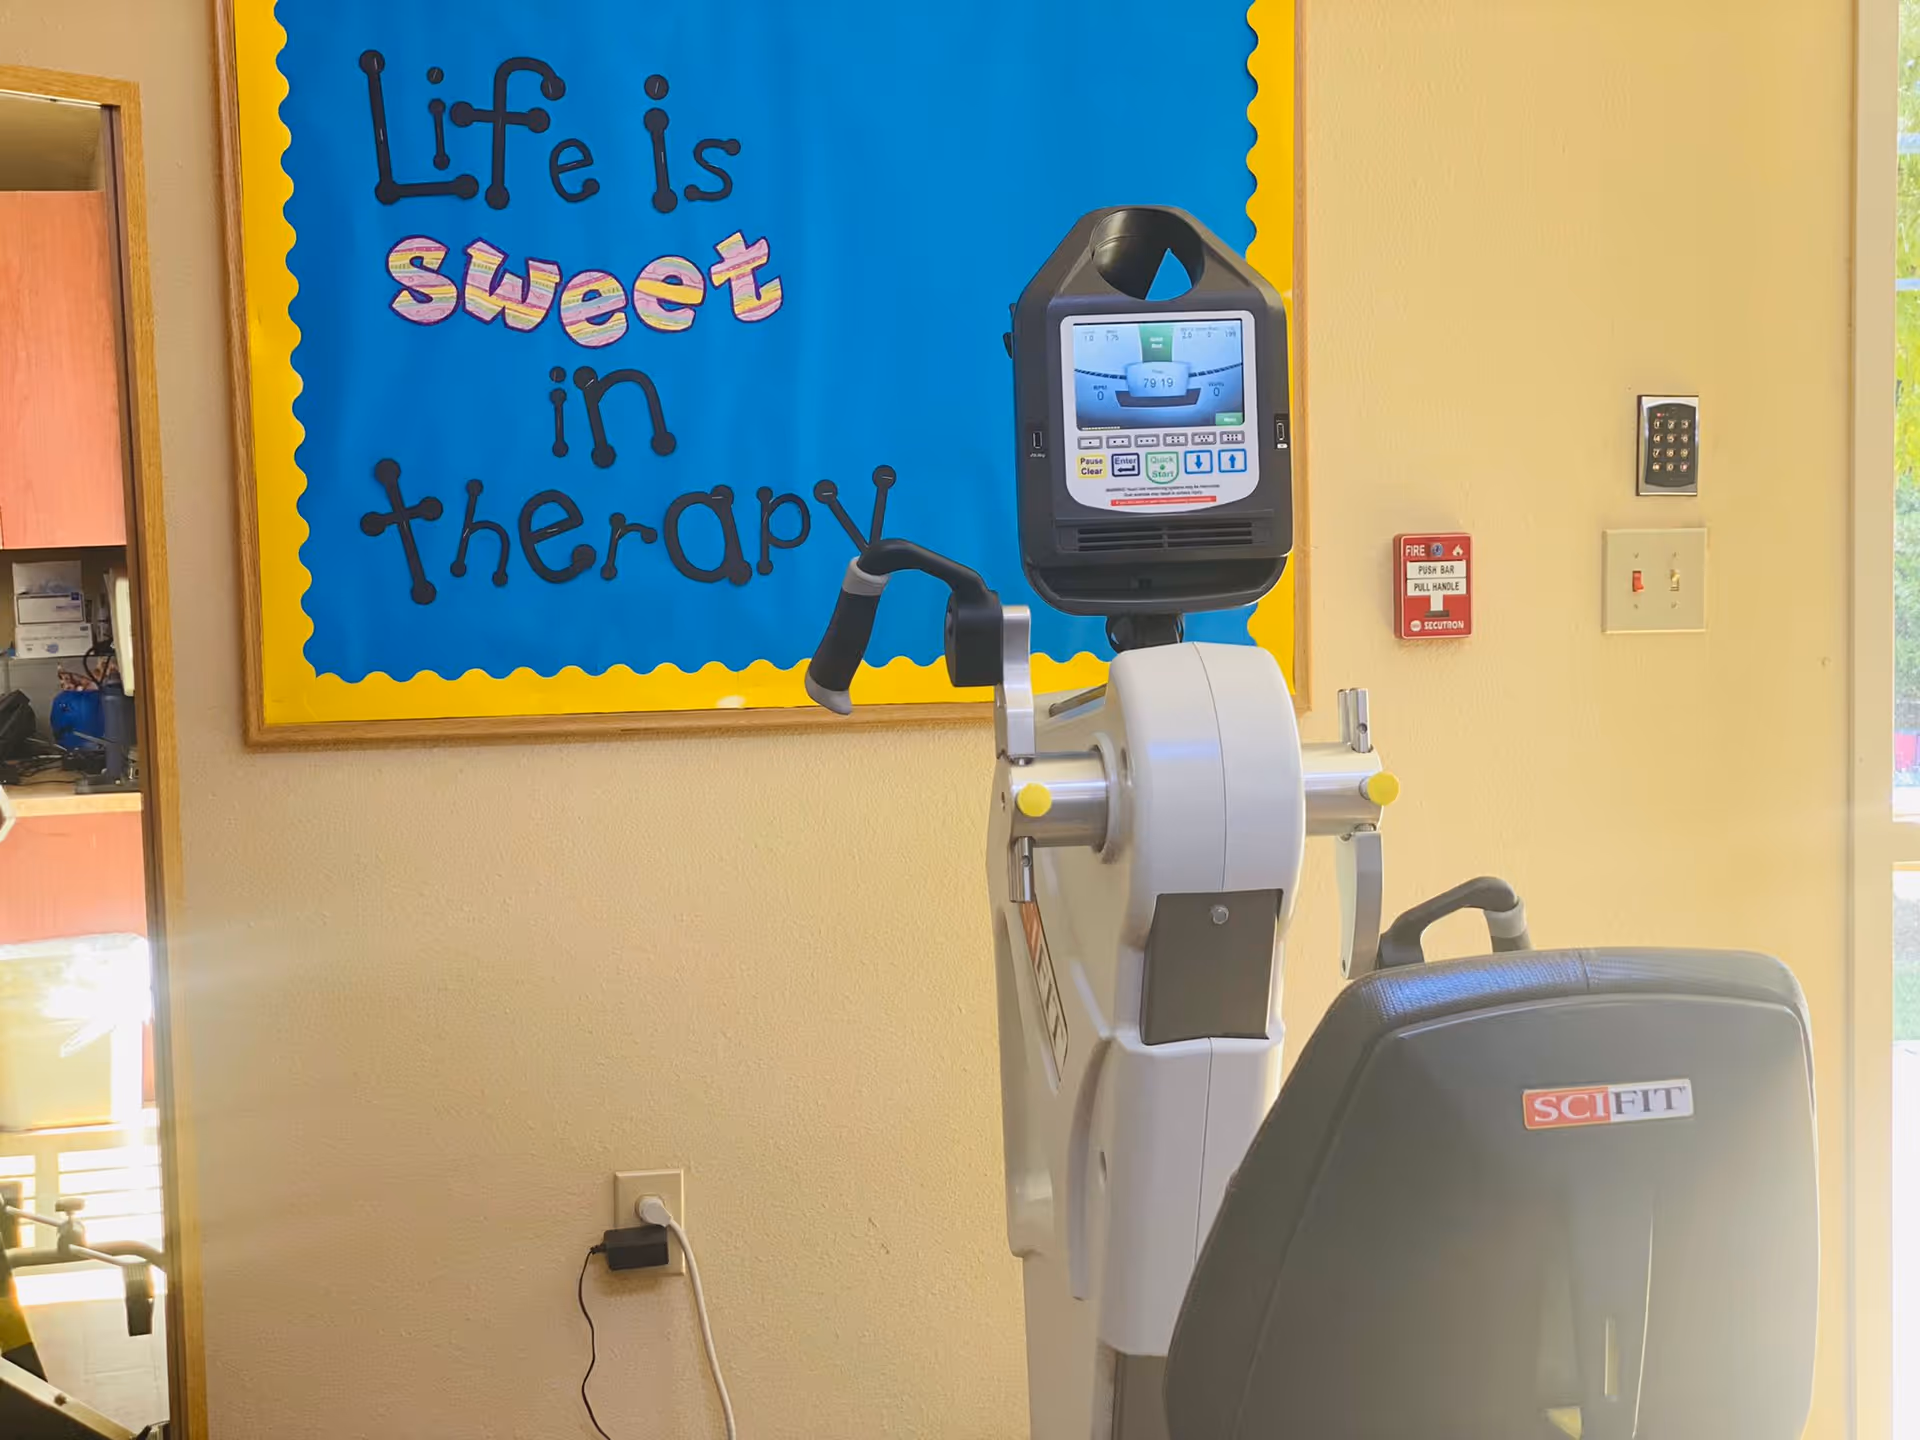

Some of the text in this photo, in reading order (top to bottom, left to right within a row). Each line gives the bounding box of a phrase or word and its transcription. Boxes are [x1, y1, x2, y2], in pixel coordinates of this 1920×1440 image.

[358, 48, 742, 213] Life is
[385, 230, 785, 349] sweet
[1096, 390, 1105, 401] 0
[1213, 387, 1221, 397] 0
[548, 365, 677, 469] in
[1080, 456, 1104, 465] Pause
[1114, 456, 1138, 465] Enter
[1150, 455, 1174, 465] Quick
[1080, 467, 1103, 475] Clear
[1151, 470, 1174, 479] Start
[360, 458, 897, 606] therapy
[1405, 544, 1426, 557] FIRE
[1418, 564, 1455, 575] PUSH BAR
[1413, 581, 1460, 592] PULL HANDLE
[1533, 1086, 1684, 1122] SCIFIT
